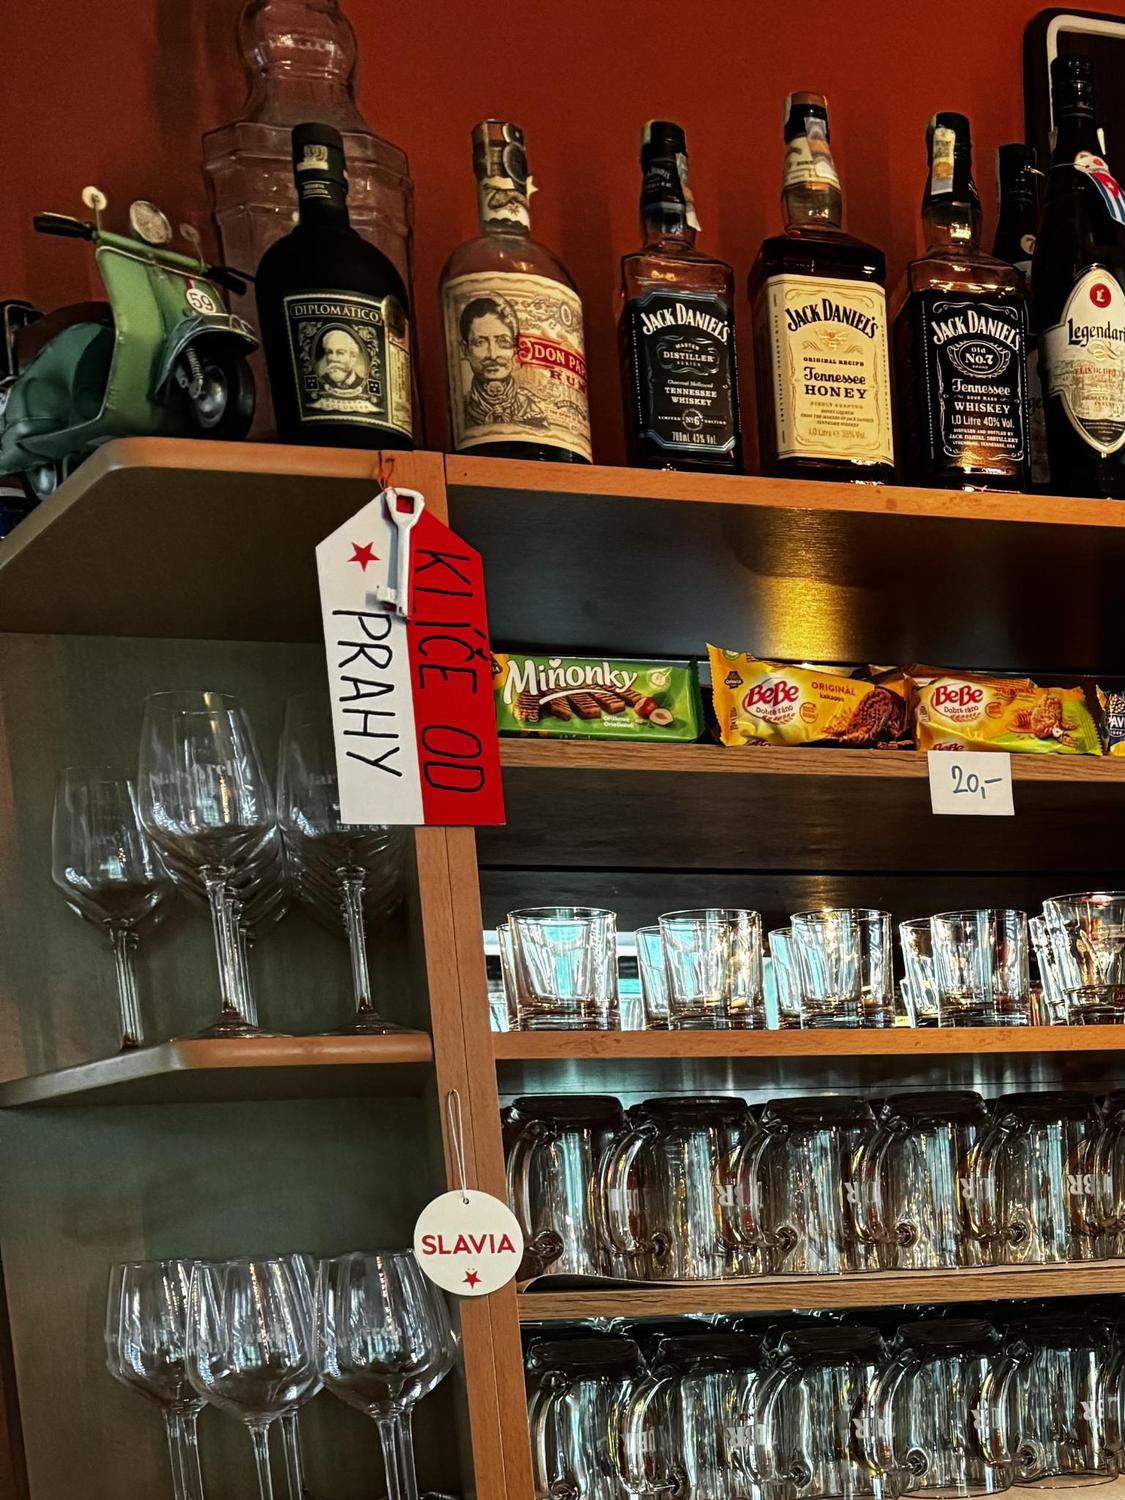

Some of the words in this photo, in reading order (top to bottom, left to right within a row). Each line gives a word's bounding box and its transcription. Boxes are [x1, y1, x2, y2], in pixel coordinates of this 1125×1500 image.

[188, 293, 214, 313] 59
[640, 310, 677, 336] JACK
[676, 302, 730, 343] DANIEL'S
[784, 304, 820, 332] JACK
[821, 298, 879, 340] DANIEL'S
[931, 316, 968, 346] JACK
[967, 310, 1022, 351] DANIEL'S
[534, 344, 566, 366] DON
[663, 351, 715, 363] DISTILLER
[803, 356, 837, 365] ORIGINAL
[838, 358, 865, 367] RECIPE
[965, 352, 994, 366] No.7
[803, 366, 866, 386] Tennessee
[664, 386, 718, 398] TENNESSEE
[804, 384, 868, 400] HONEY
[952, 378, 1011, 396] Tennessee
[671, 396, 712, 407] WHISKEY
[954, 401, 1011, 414] WHISKEY
[963, 414, 982, 426] Litre
[983, 416, 1000, 427] 40%
[1001, 418, 1016, 428] Vol.
[332, 609, 403, 778] PRAHY
[747, 680, 799, 708] BeBe
[934, 685, 984, 707] BeBe
[421, 724, 485, 793] OD
[421, 1233, 517, 1256] SLAVIA
